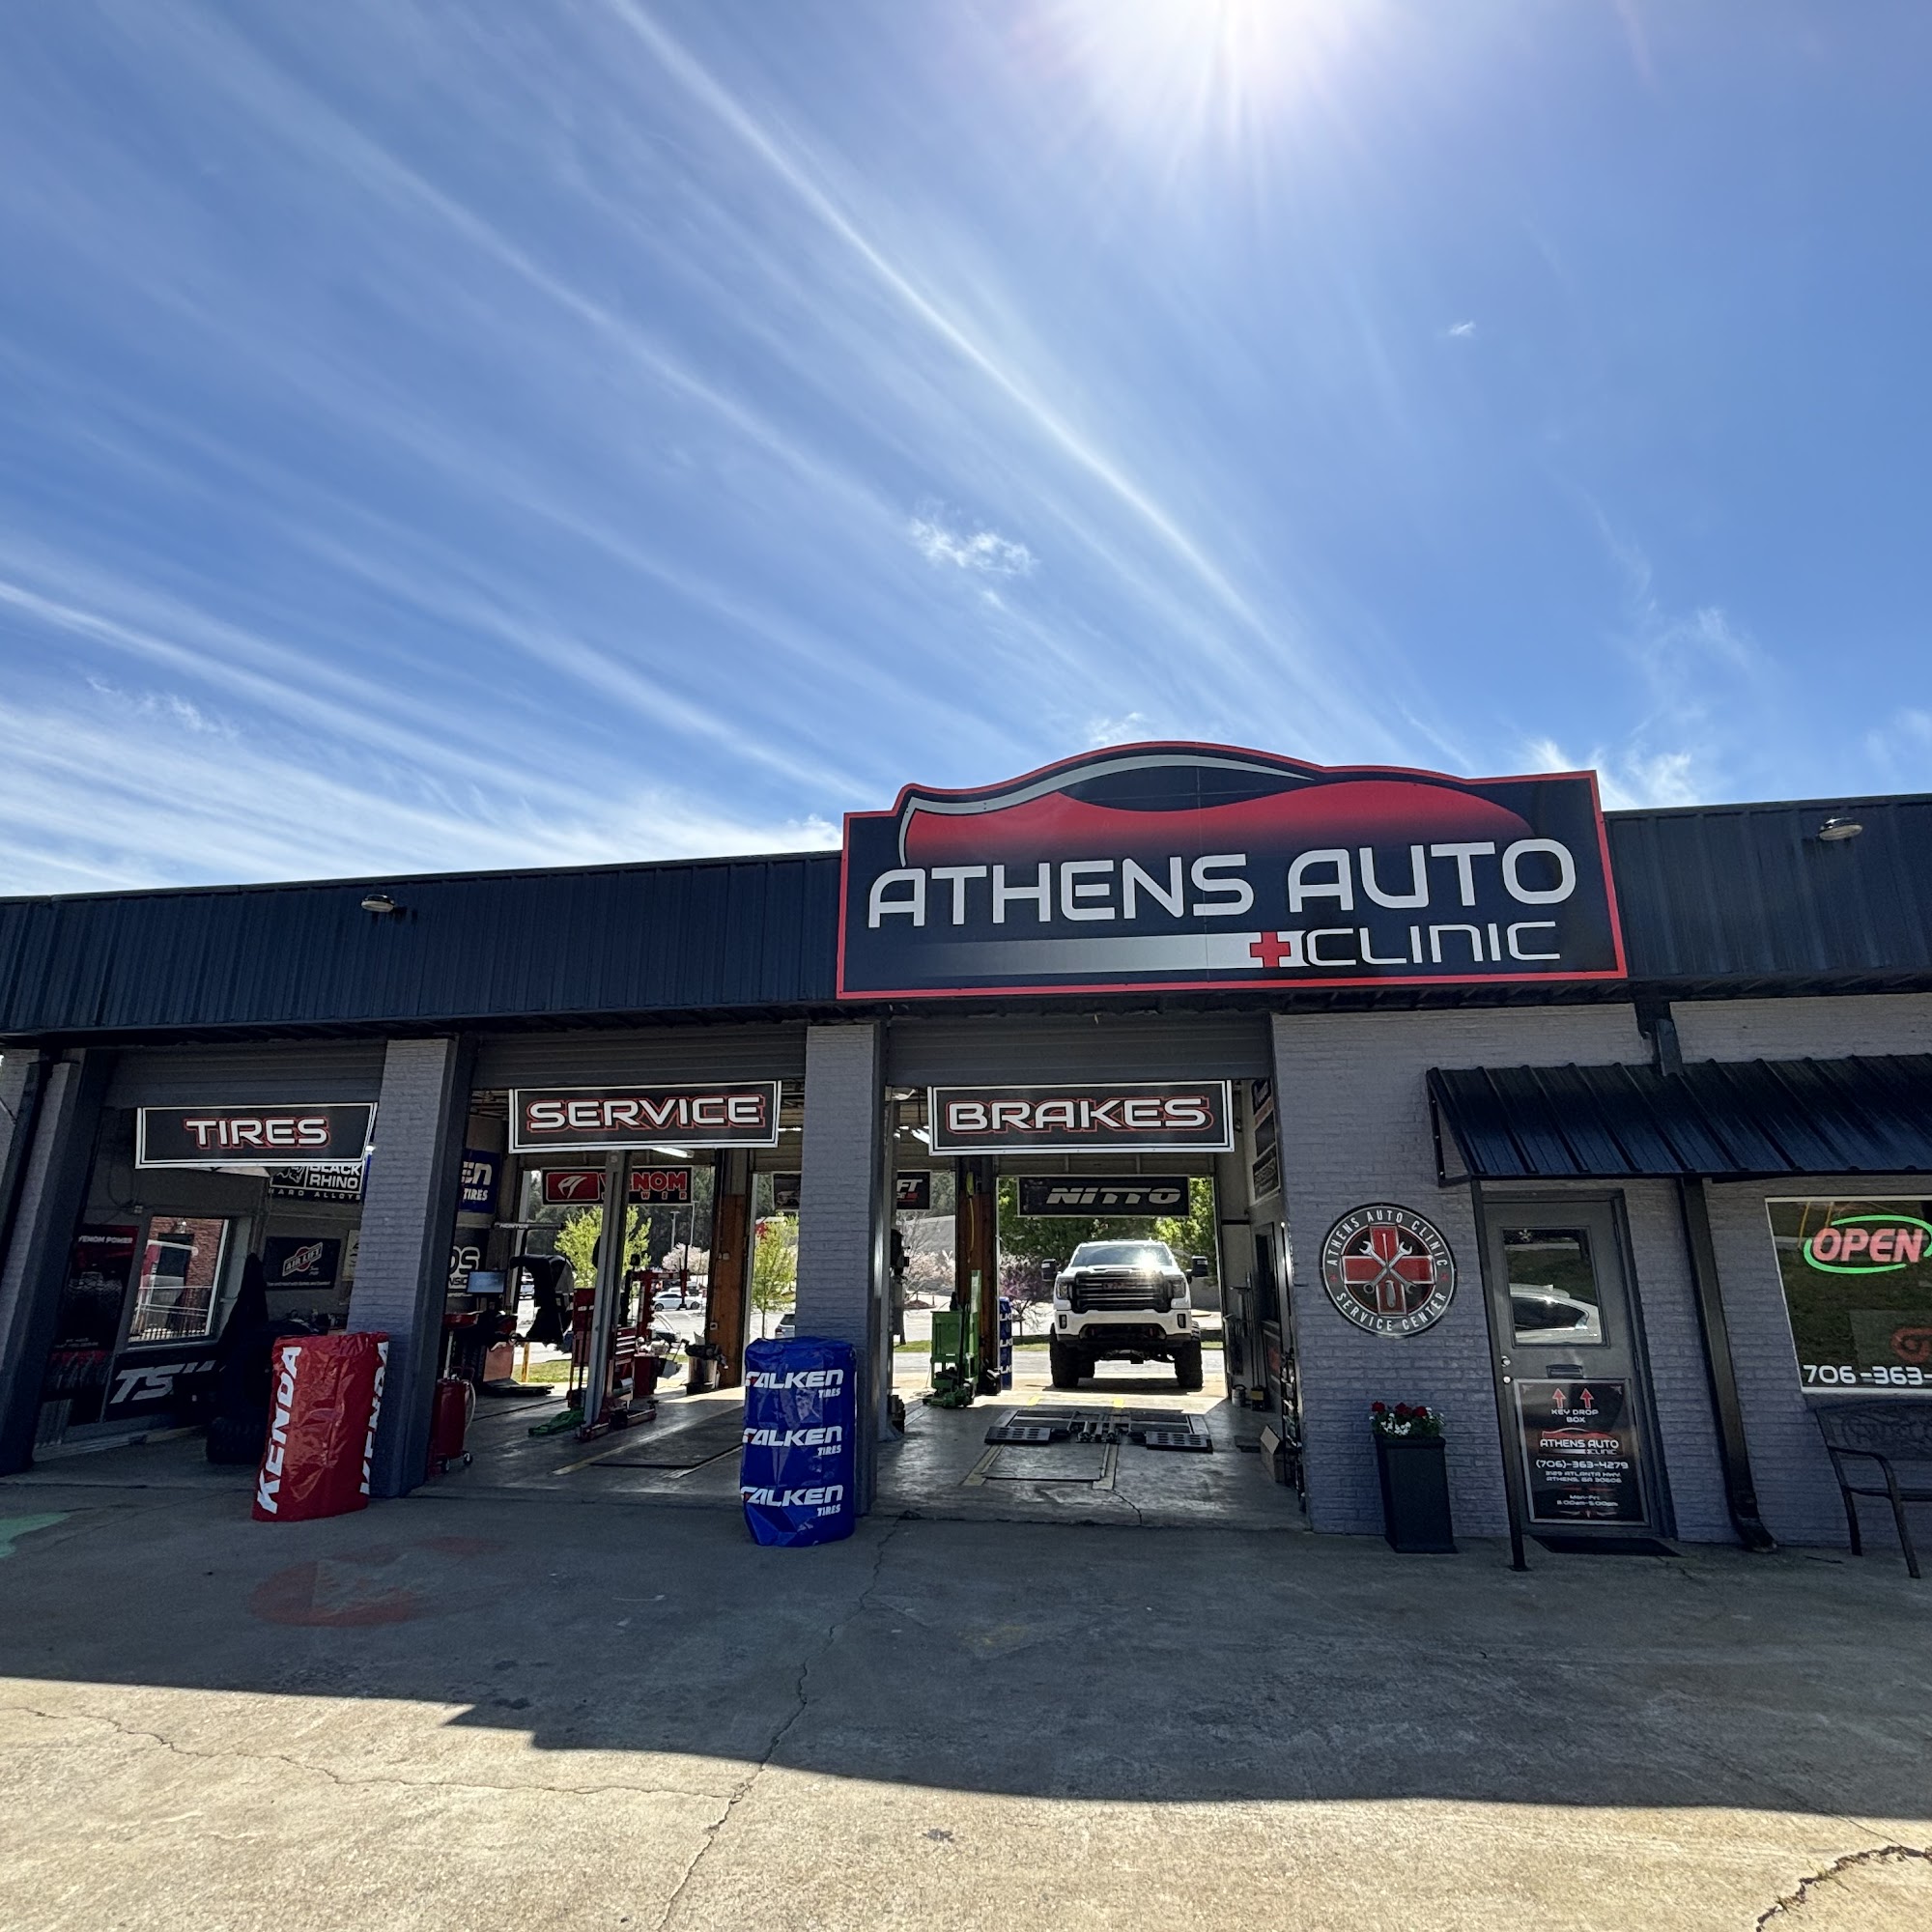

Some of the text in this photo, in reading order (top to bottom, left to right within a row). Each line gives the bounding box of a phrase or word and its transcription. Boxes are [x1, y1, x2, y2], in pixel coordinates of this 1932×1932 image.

[868, 838, 1577, 928] ATHENS AUTO
[1307, 921, 1561, 967] CLINIC
[528, 1095, 762, 1130] SERVICE
[948, 1097, 1208, 1131] BRAKES
[185, 1118, 329, 1147] TIRES
[308, 1173, 359, 1189] RHINO
[599, 1171, 687, 1192] NOM
[268, 1188, 361, 1201] HARD ALLOYS
[463, 1187, 489, 1202] TIRES
[1045, 1187, 1181, 1205] NITTO
[1326, 1209, 1448, 1266] ATHENS AUTO CLINIC
[1812, 1227, 1923, 1264] OPEN
[285, 1257, 301, 1271] AIR
[1336, 1293, 1447, 1331] SERVICE CENTER
[745, 1369, 844, 1389] FALKEN
[818, 1387, 841, 1399] TIRES
[257, 1347, 302, 1515] KENDA
[742, 1425, 843, 1447] FALKEN
[817, 1444, 841, 1457] TIRES
[1540, 1438, 1619, 1449] ATHENS AUTO
[1535, 1459, 1630, 1469] (706)-363-4279
[740, 1485, 844, 1508] FALKEN
[816, 1504, 841, 1517] TIRES
